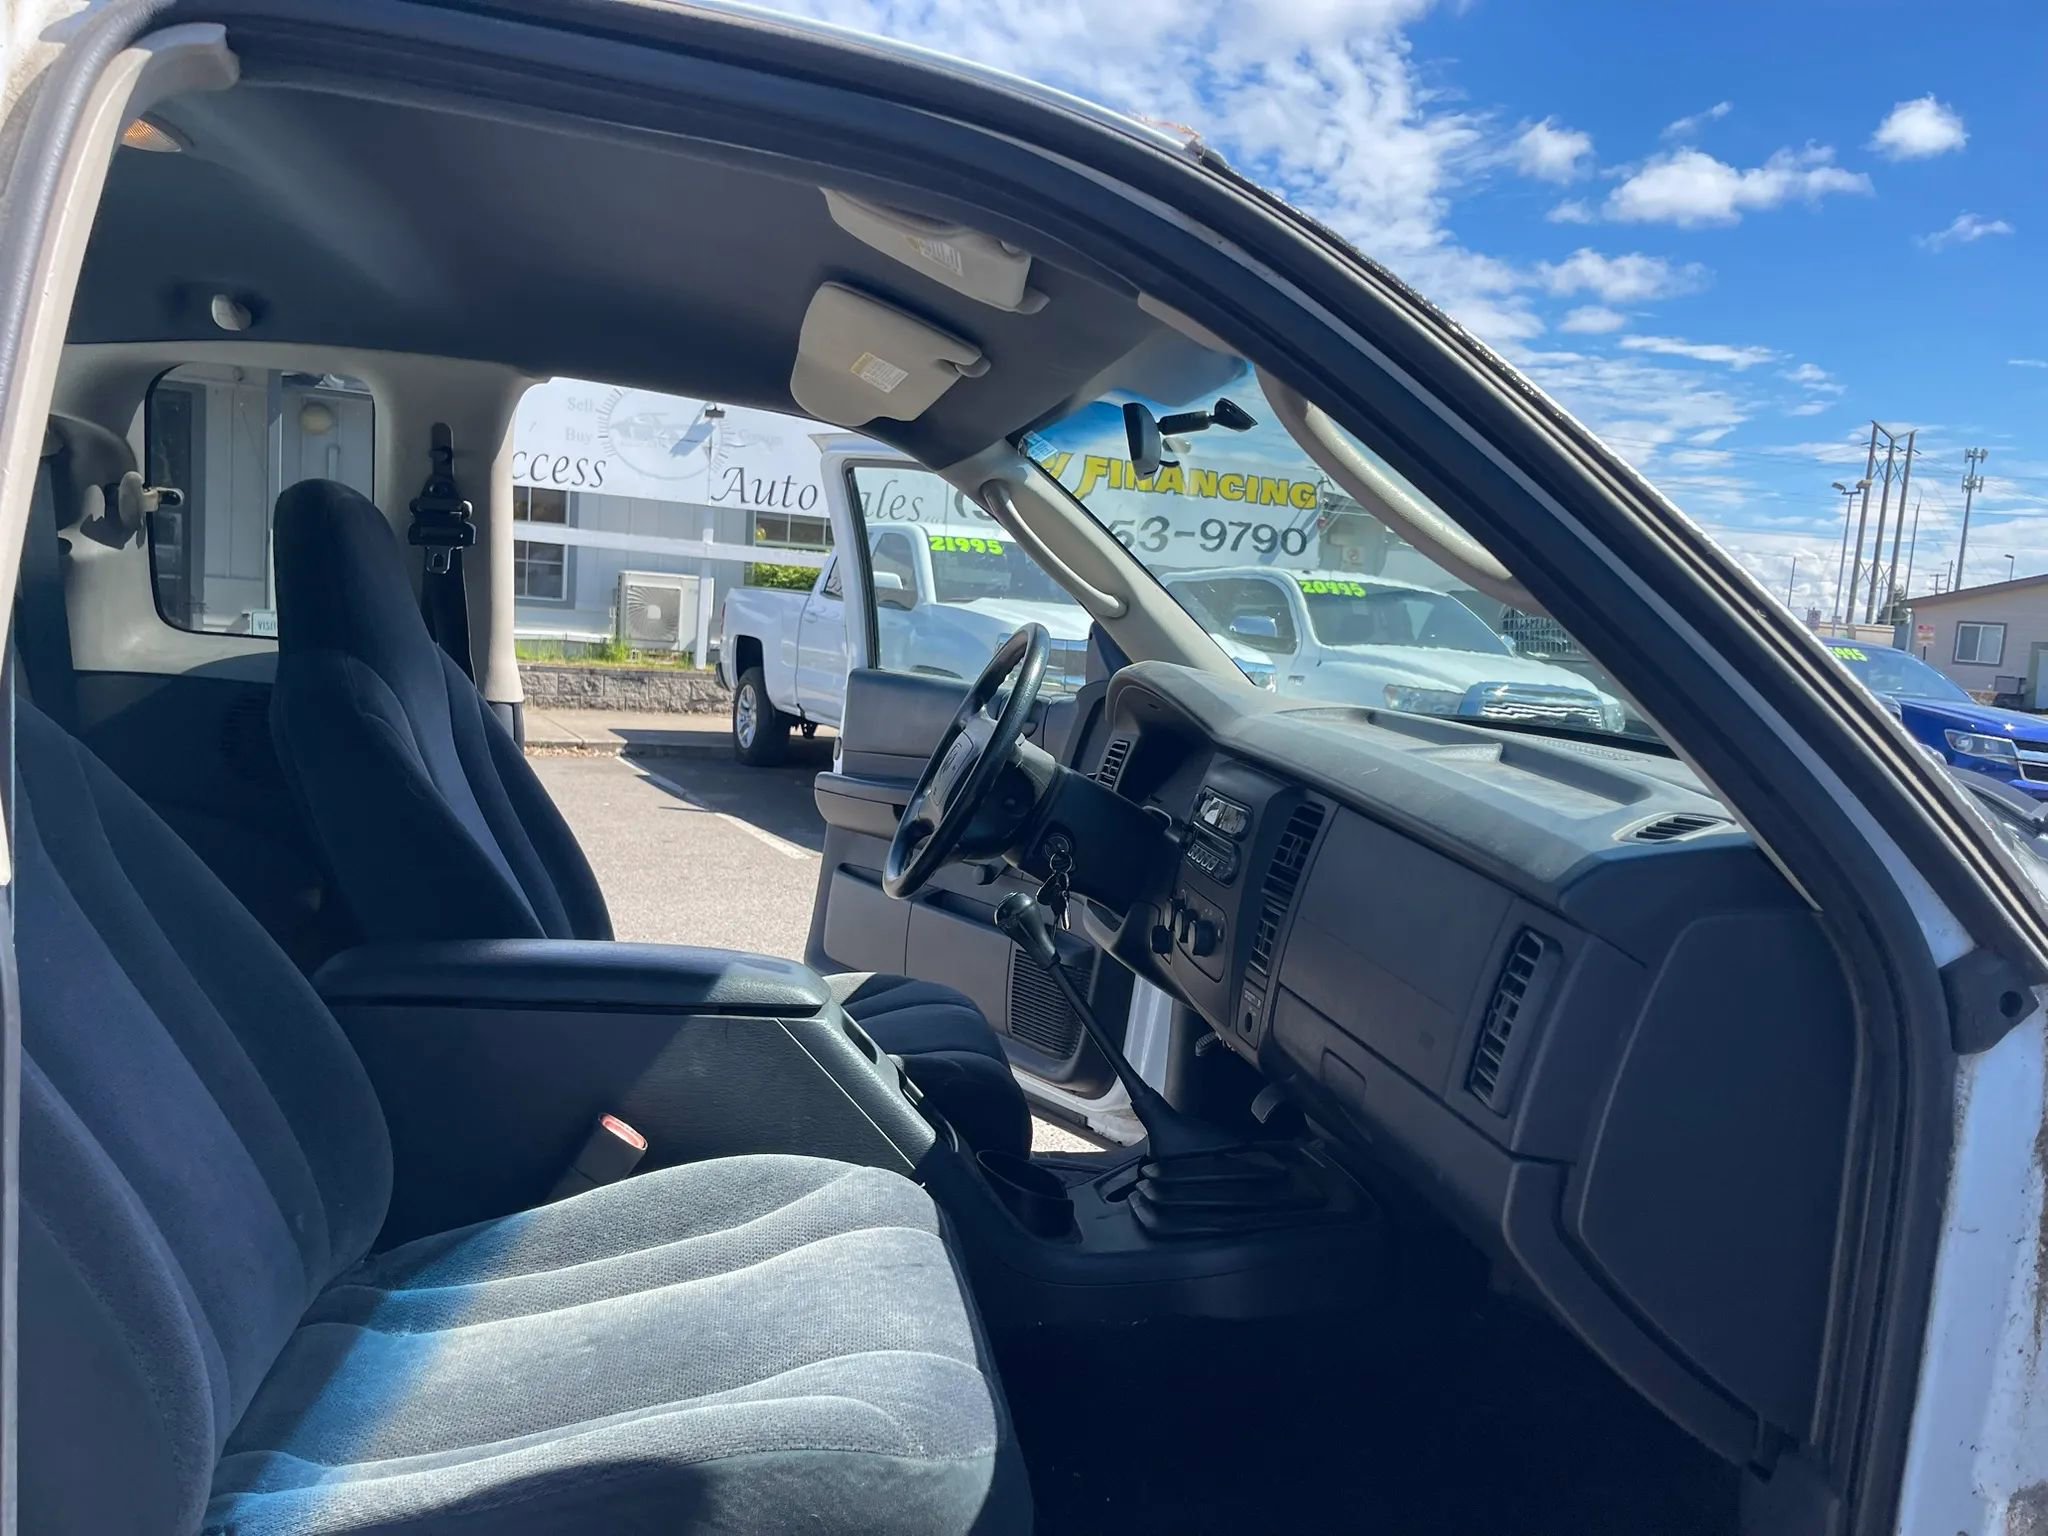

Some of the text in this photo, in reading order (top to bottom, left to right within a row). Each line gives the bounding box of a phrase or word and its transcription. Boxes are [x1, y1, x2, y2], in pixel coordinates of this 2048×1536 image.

[567, 396, 593, 412] Sell
[565, 426, 593, 445] Buy
[513, 451, 606, 488] ccess
[711, 467, 818, 511] Auto
[860, 479, 923, 522] ales
[929, 535, 1004, 556] 21995
